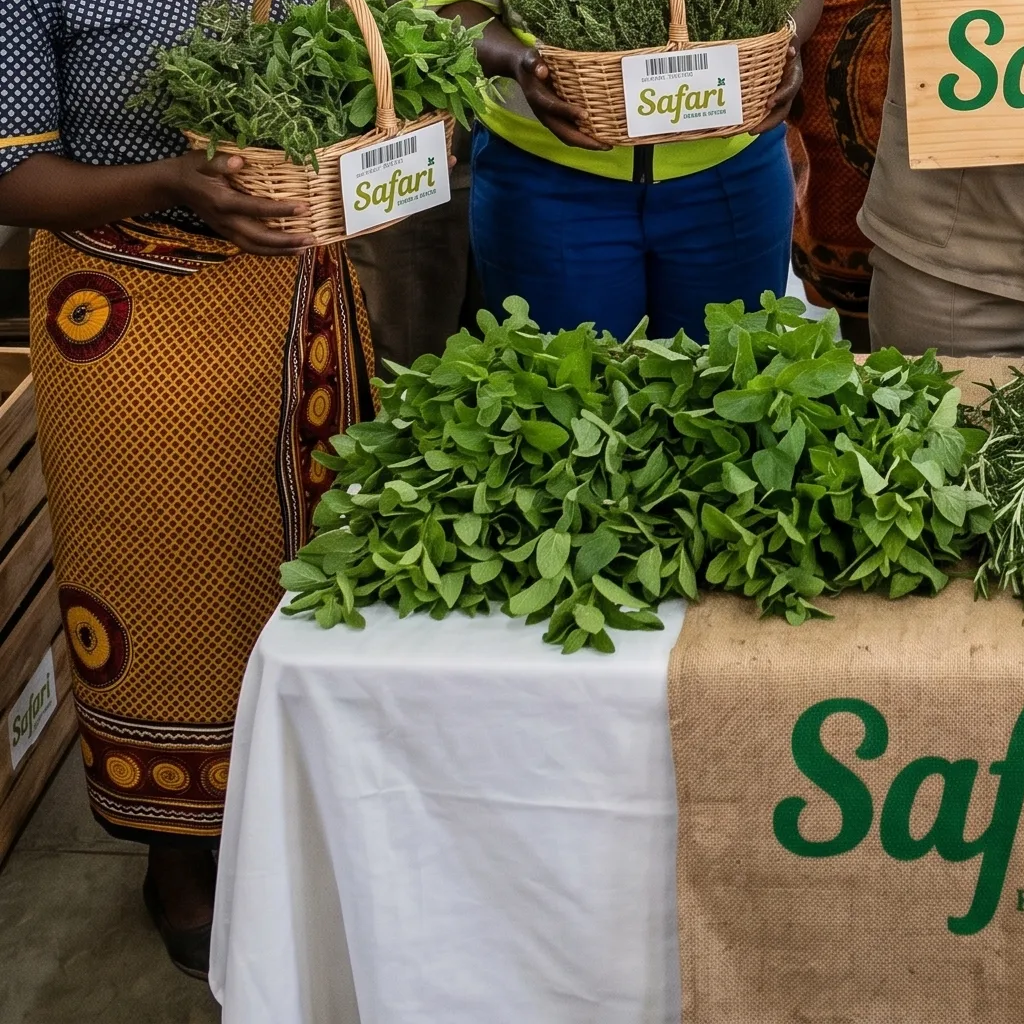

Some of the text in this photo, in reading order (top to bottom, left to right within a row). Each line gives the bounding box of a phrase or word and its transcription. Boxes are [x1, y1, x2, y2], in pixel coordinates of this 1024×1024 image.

[637, 84, 725, 124] Safari
[353, 168, 435, 213] Safari
[12, 673, 50, 747] Safari
